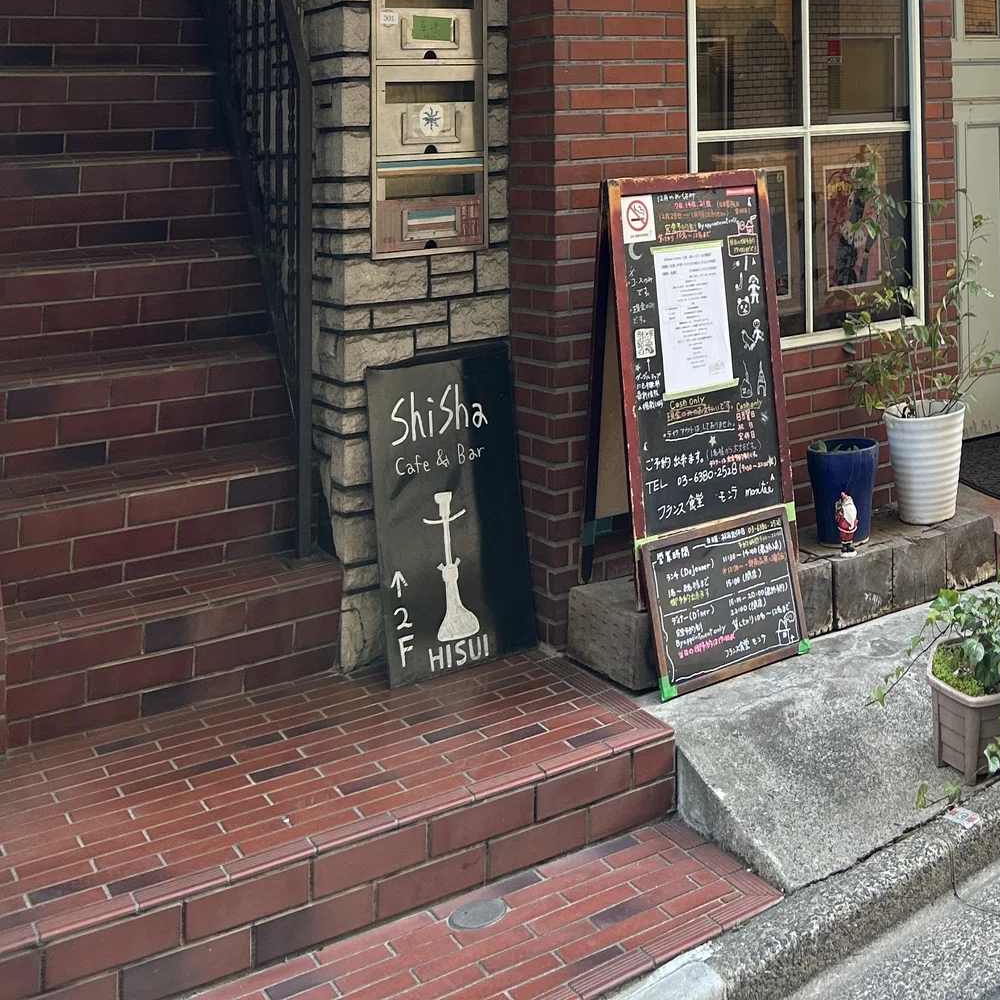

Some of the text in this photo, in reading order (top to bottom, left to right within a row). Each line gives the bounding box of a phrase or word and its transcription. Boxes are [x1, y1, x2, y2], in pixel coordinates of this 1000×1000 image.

[669, 398, 689, 410] Cash
[394, 444, 485, 477] Cafe & Bar
[645, 479, 668, 495] TEL
[657, 492, 705, 521] フランス食堂
[717, 486, 738, 503] モンテ
[656, 545, 690, 565] 営業時間
[726, 576, 741, 588] 15:00
[730, 605, 748, 616] 22:00
[428, 633, 490, 672] HISUI
